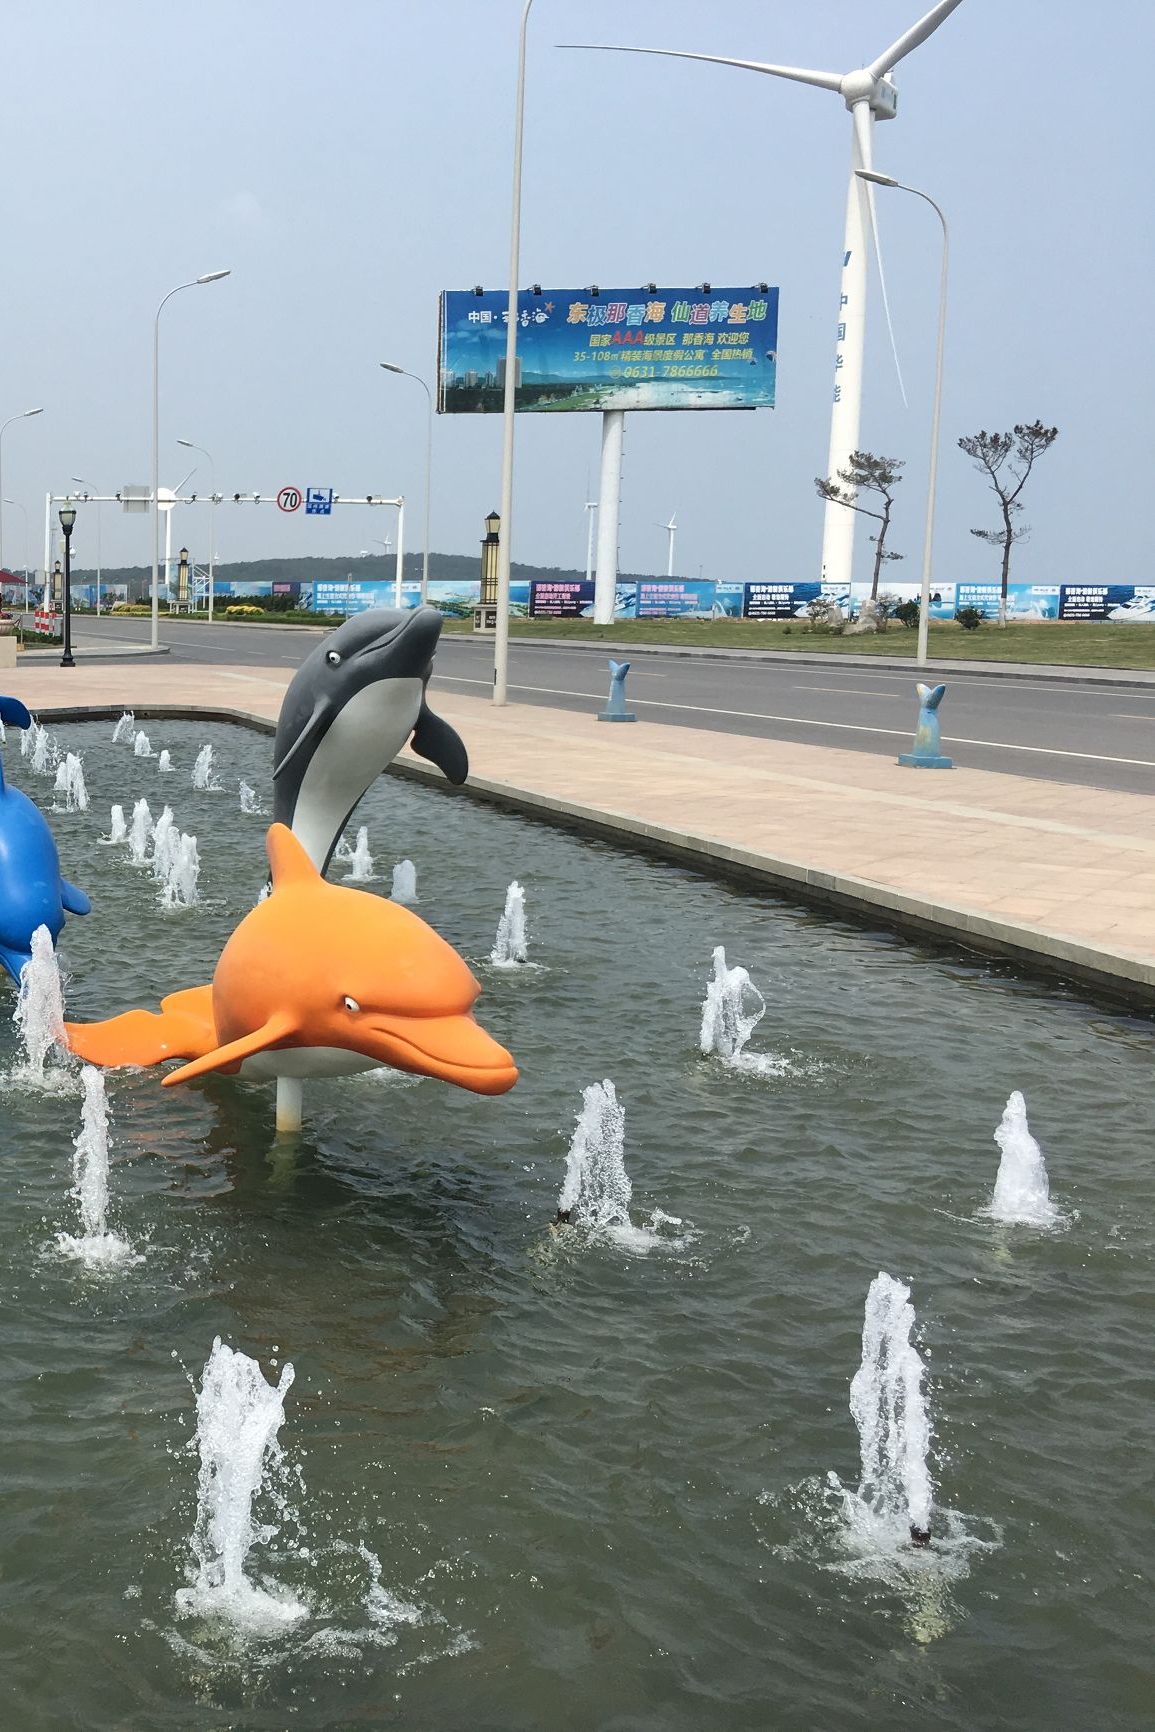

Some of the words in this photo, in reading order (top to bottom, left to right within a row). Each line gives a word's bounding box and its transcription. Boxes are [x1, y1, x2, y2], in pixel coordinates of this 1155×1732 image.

[566, 301, 666, 326] 东极那香海
[670, 299, 768, 325] 仙道养生地
[589, 330, 676, 347] 国家AAA级景区
[682, 332, 715, 346] 那香海
[716, 331, 750, 345] 欢迎您
[283, 492, 298, 508] 70
